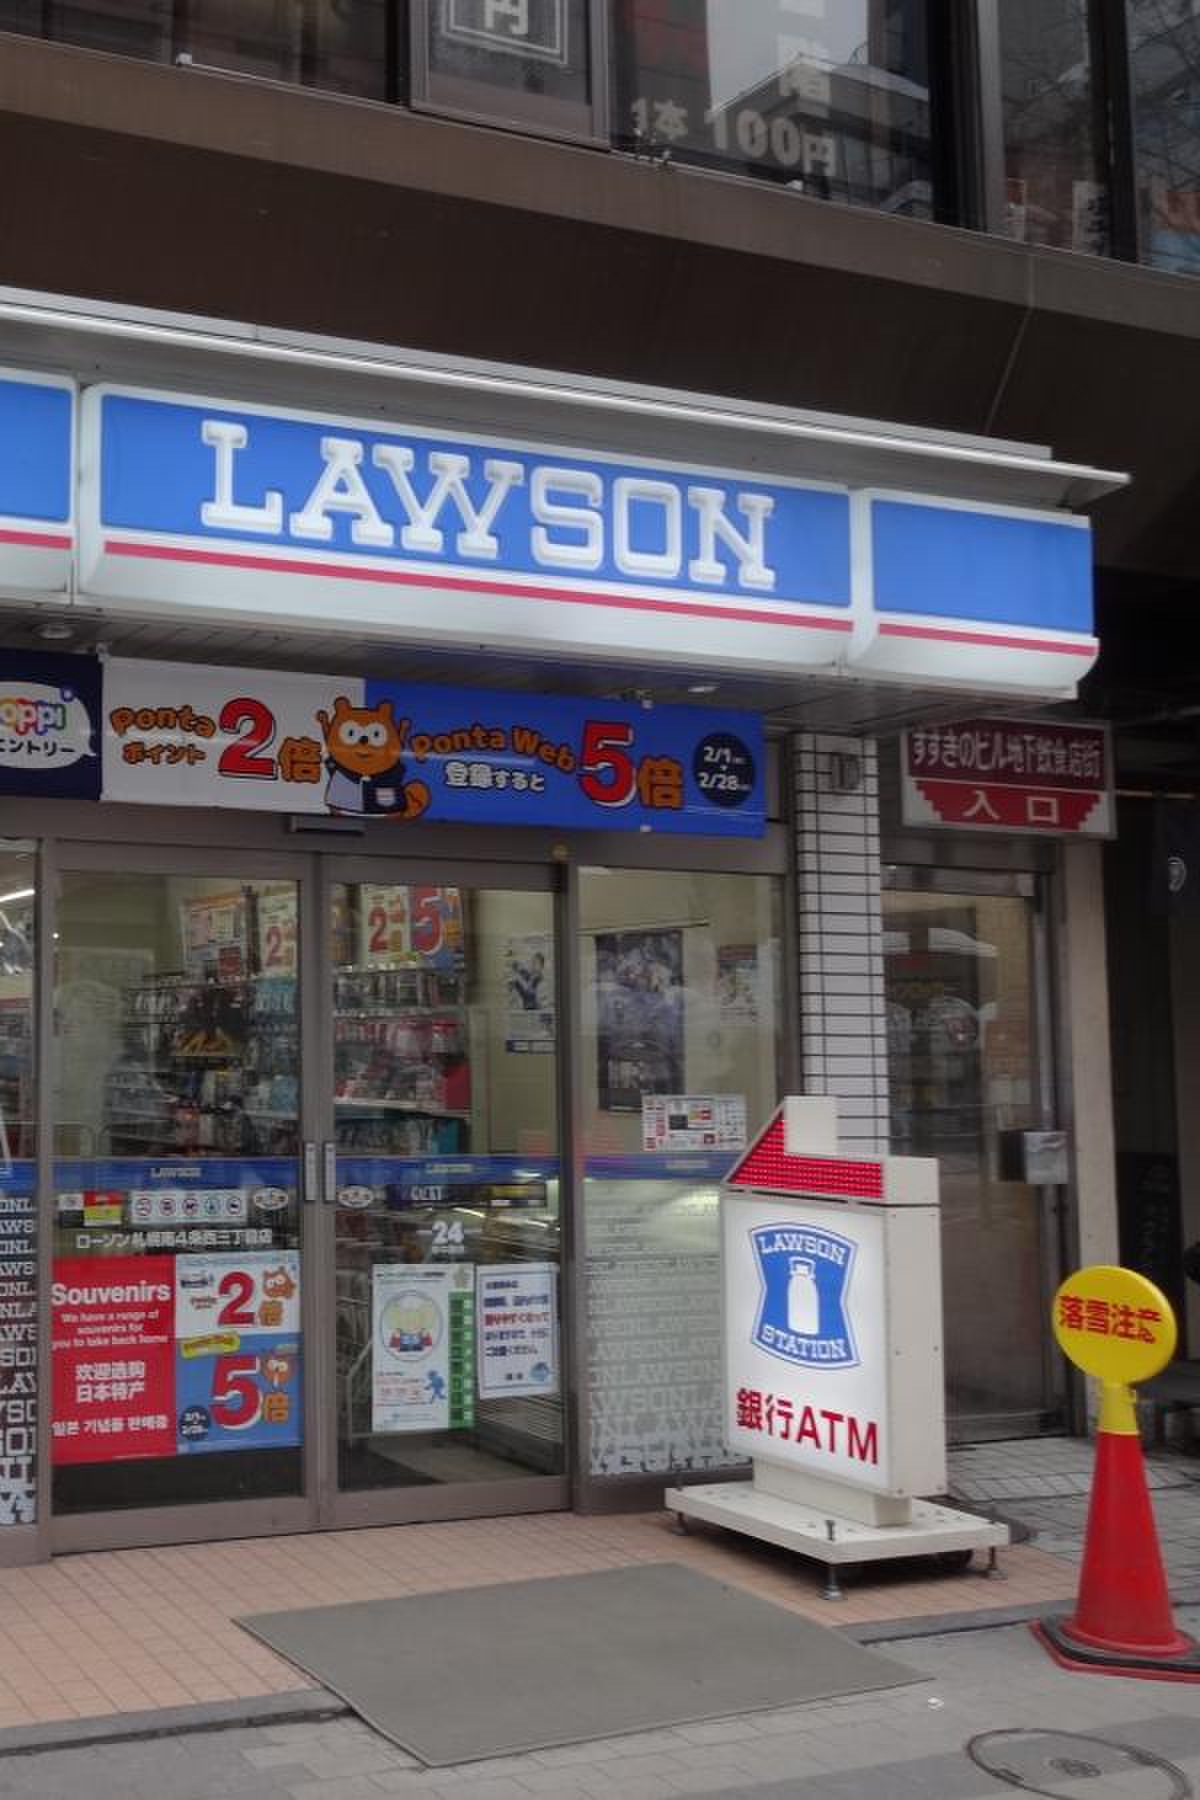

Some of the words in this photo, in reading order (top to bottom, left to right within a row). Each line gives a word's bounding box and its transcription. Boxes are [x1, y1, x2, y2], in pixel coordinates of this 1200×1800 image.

[201, 419, 775, 591] LAWSON
[122, 741, 206, 766] ポイント
[511, 725, 576, 772] Web
[445, 761, 545, 793] 登録すると
[962, 790, 1060, 824] 入口
[431, 1220, 465, 1245] 24
[758, 1233, 846, 1266] LAWSON
[52, 1280, 172, 1306] Souvenirs
[761, 1323, 847, 1360] STATION
[736, 1387, 878, 1466] 銀行ATM
